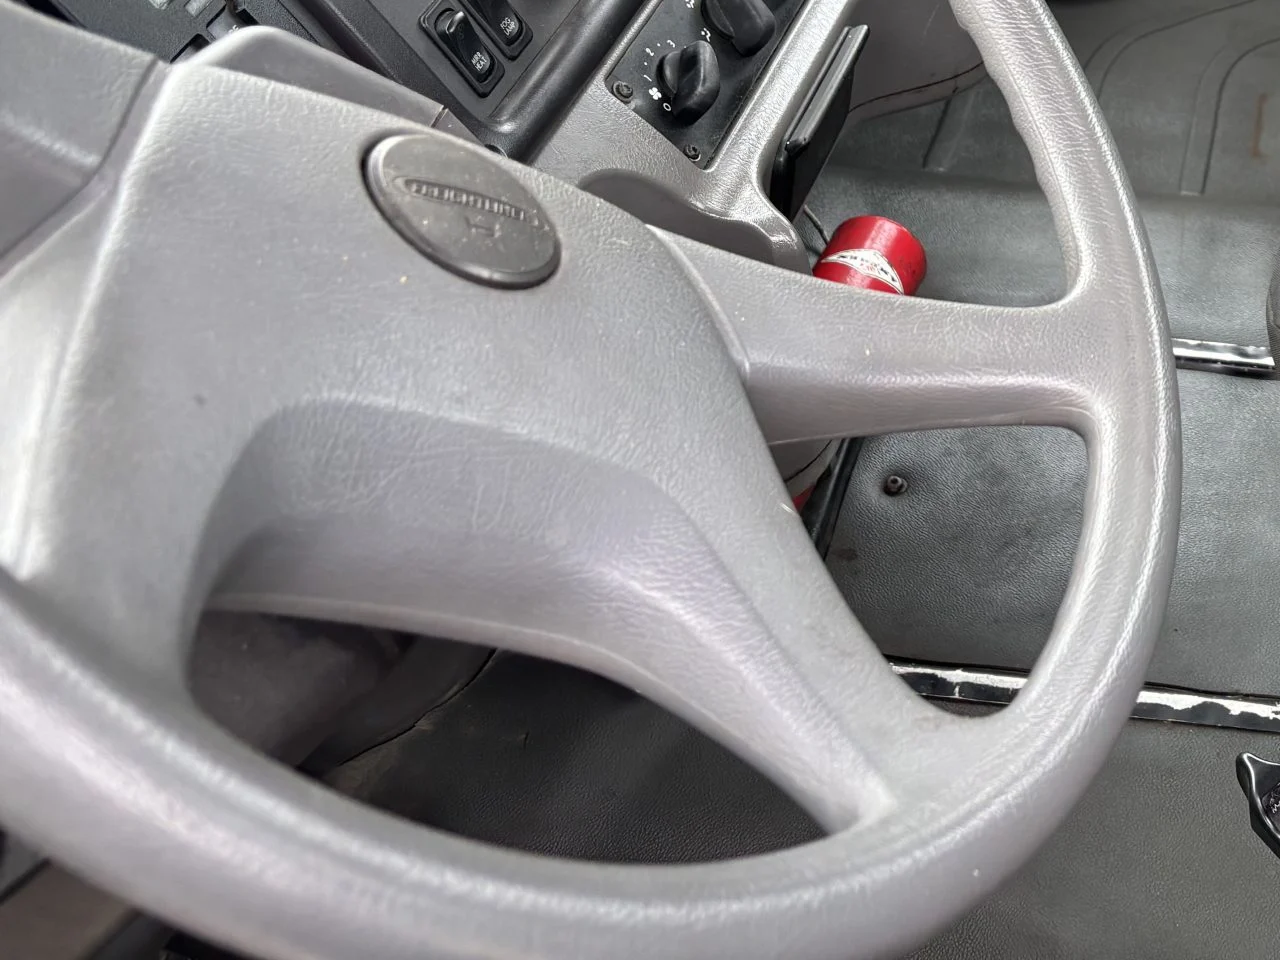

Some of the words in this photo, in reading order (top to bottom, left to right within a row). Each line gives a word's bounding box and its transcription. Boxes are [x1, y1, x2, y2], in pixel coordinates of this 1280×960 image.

[500, 17, 511, 29] FOG
[503, 21, 516, 36] LAMP
[667, 39, 676, 48] 3
[645, 47, 655, 56] 2
[476, 55, 488, 72] HEAT
[643, 74, 652, 82] 1
